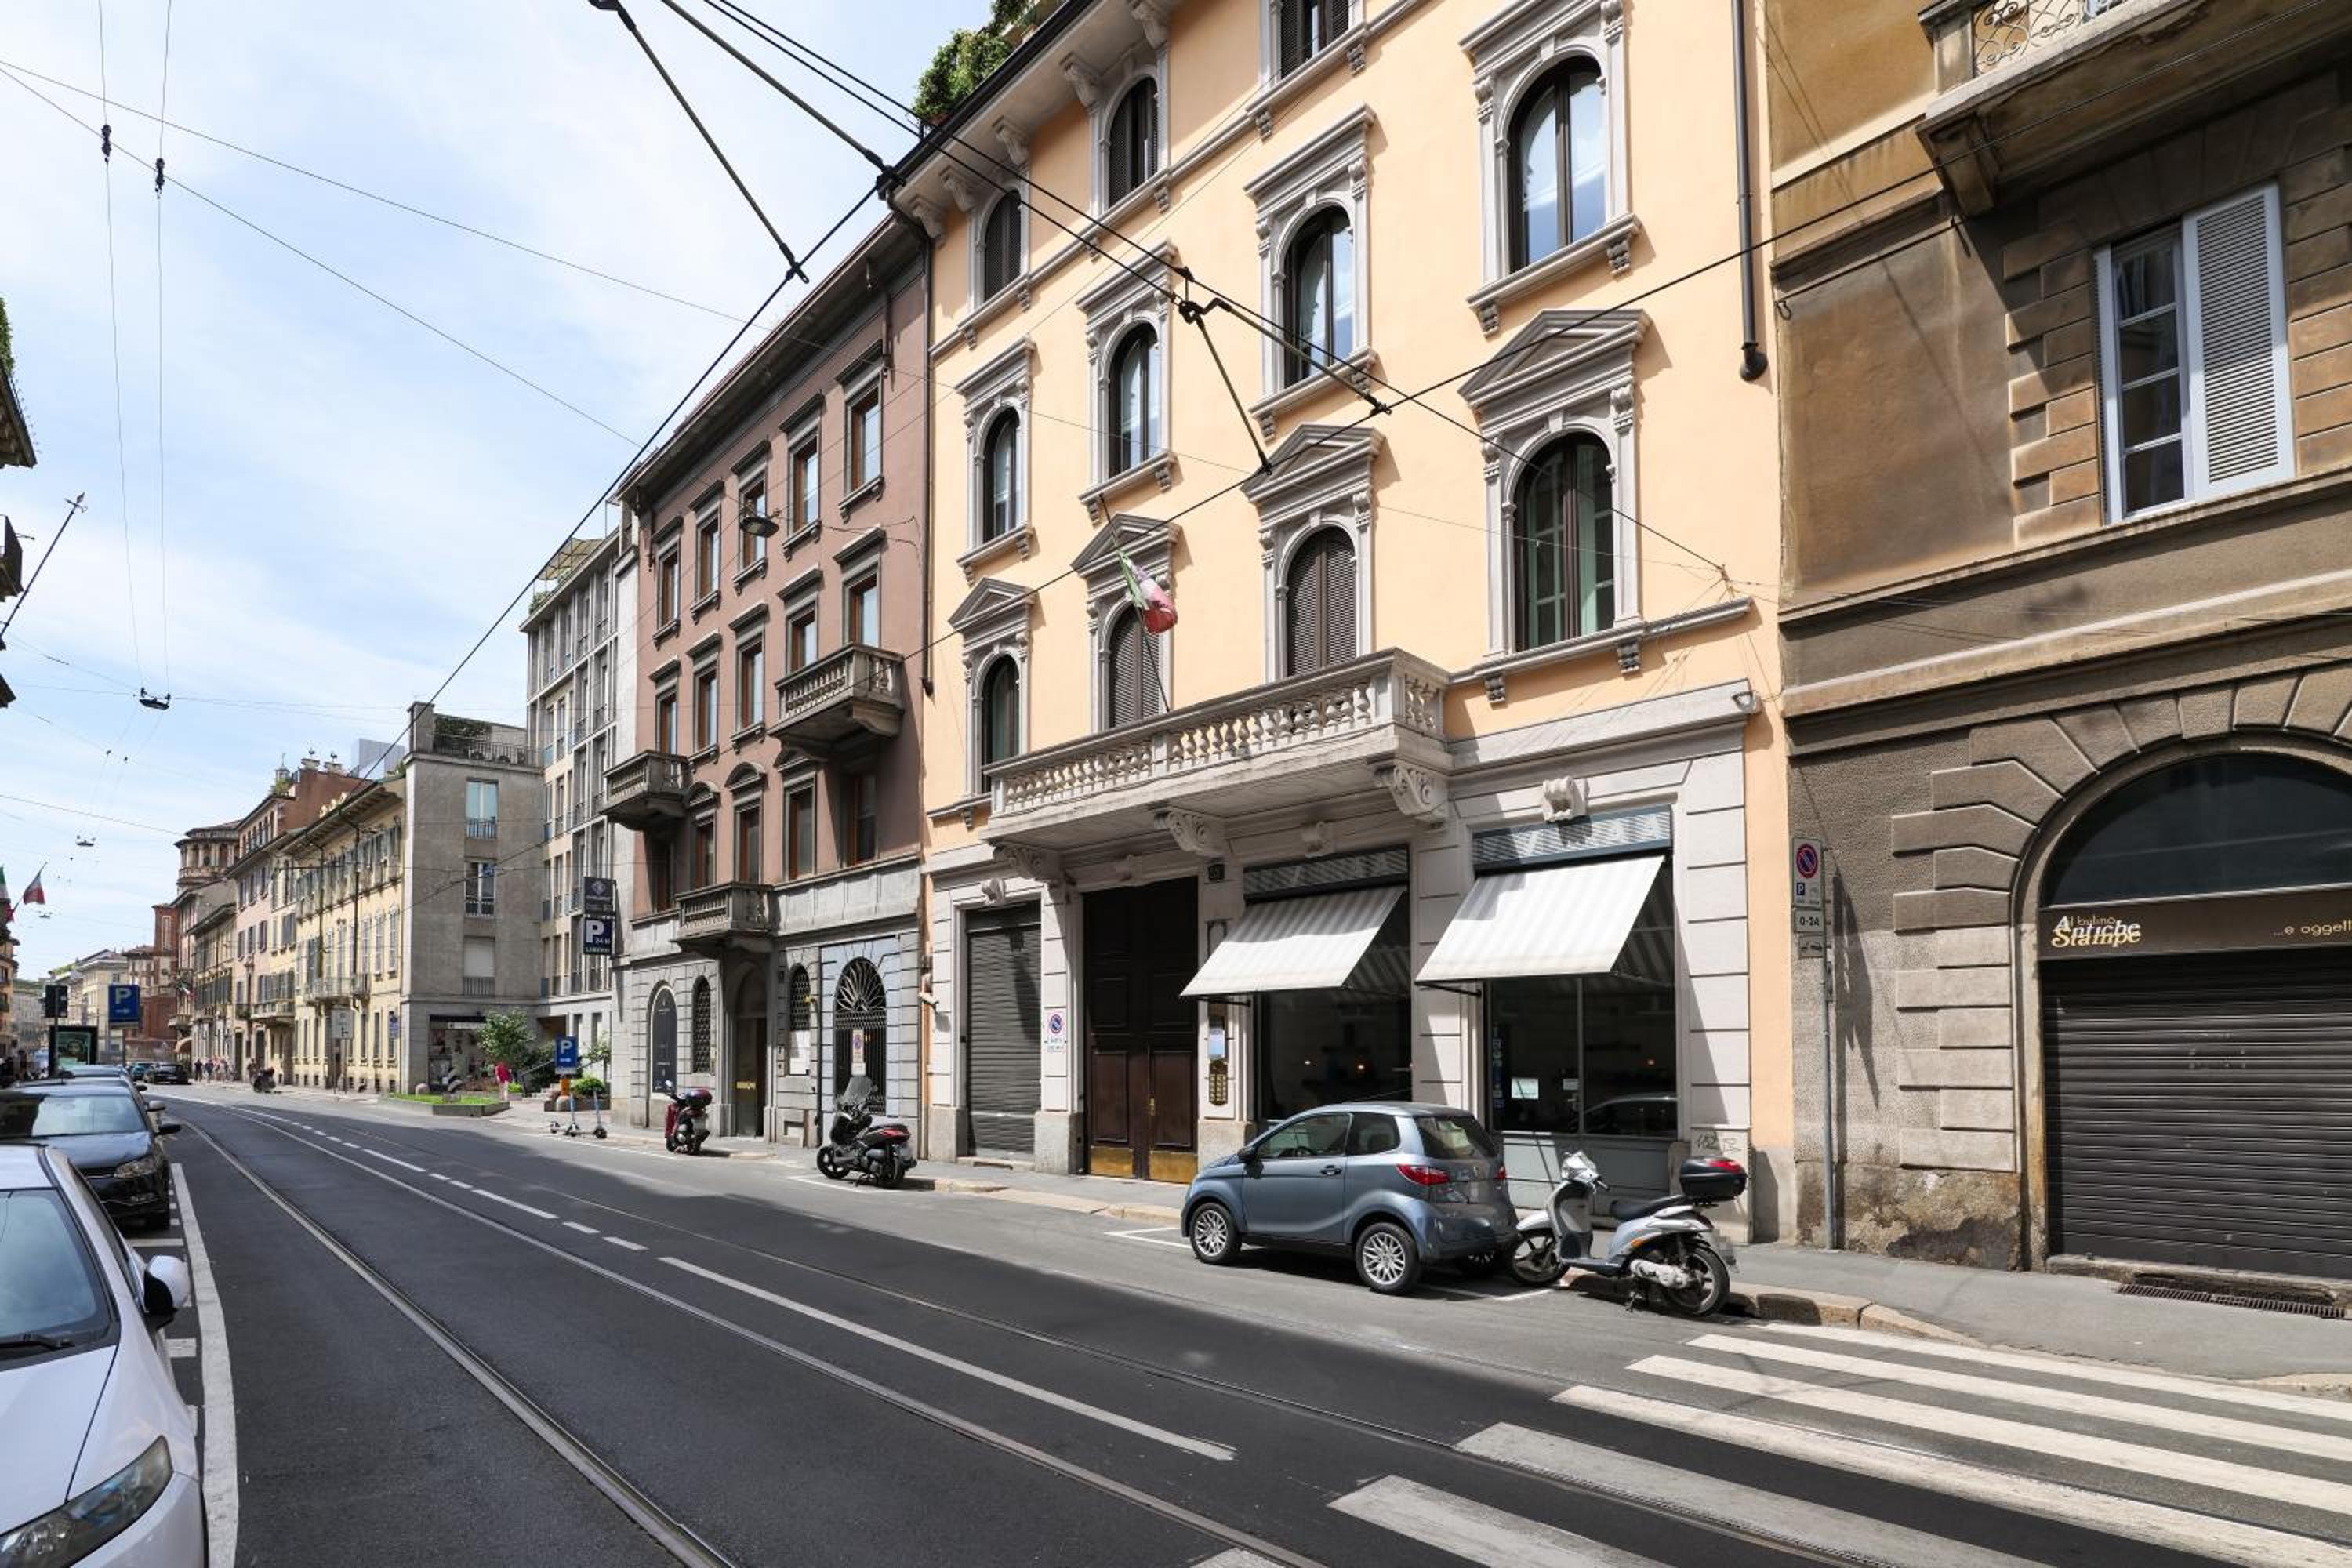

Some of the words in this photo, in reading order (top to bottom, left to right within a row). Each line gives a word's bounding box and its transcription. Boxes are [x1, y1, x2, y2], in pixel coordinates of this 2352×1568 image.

[586, 920, 604, 943] P
[2053, 915, 2142, 938] Antiche
[2051, 927, 2141, 947] Stampe
[115, 988, 132, 1004] P
[561, 1040, 573, 1054] P
